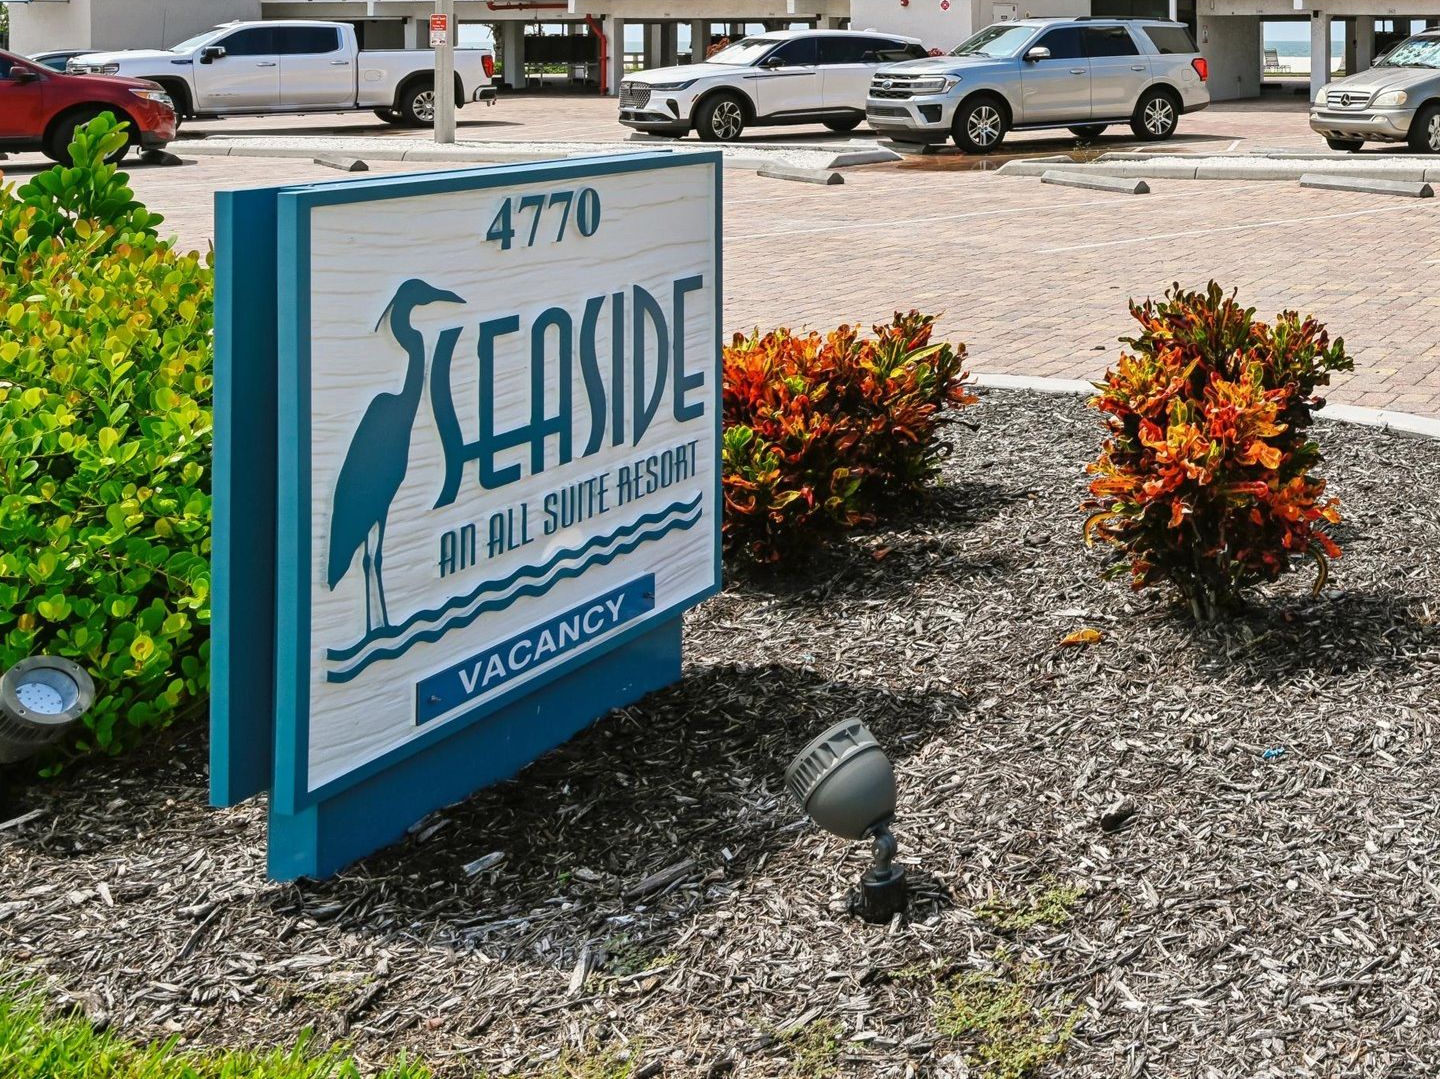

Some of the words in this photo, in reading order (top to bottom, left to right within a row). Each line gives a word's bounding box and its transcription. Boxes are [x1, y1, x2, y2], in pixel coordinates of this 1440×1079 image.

[486, 187, 601, 250] 4770
[430, 274, 704, 510] SEASIDE
[438, 523, 476, 578] AN
[487, 503, 534, 558] ALL
[543, 472, 609, 536] SUITE
[617, 440, 698, 506] RESORT
[458, 593, 625, 694] VACANCY
